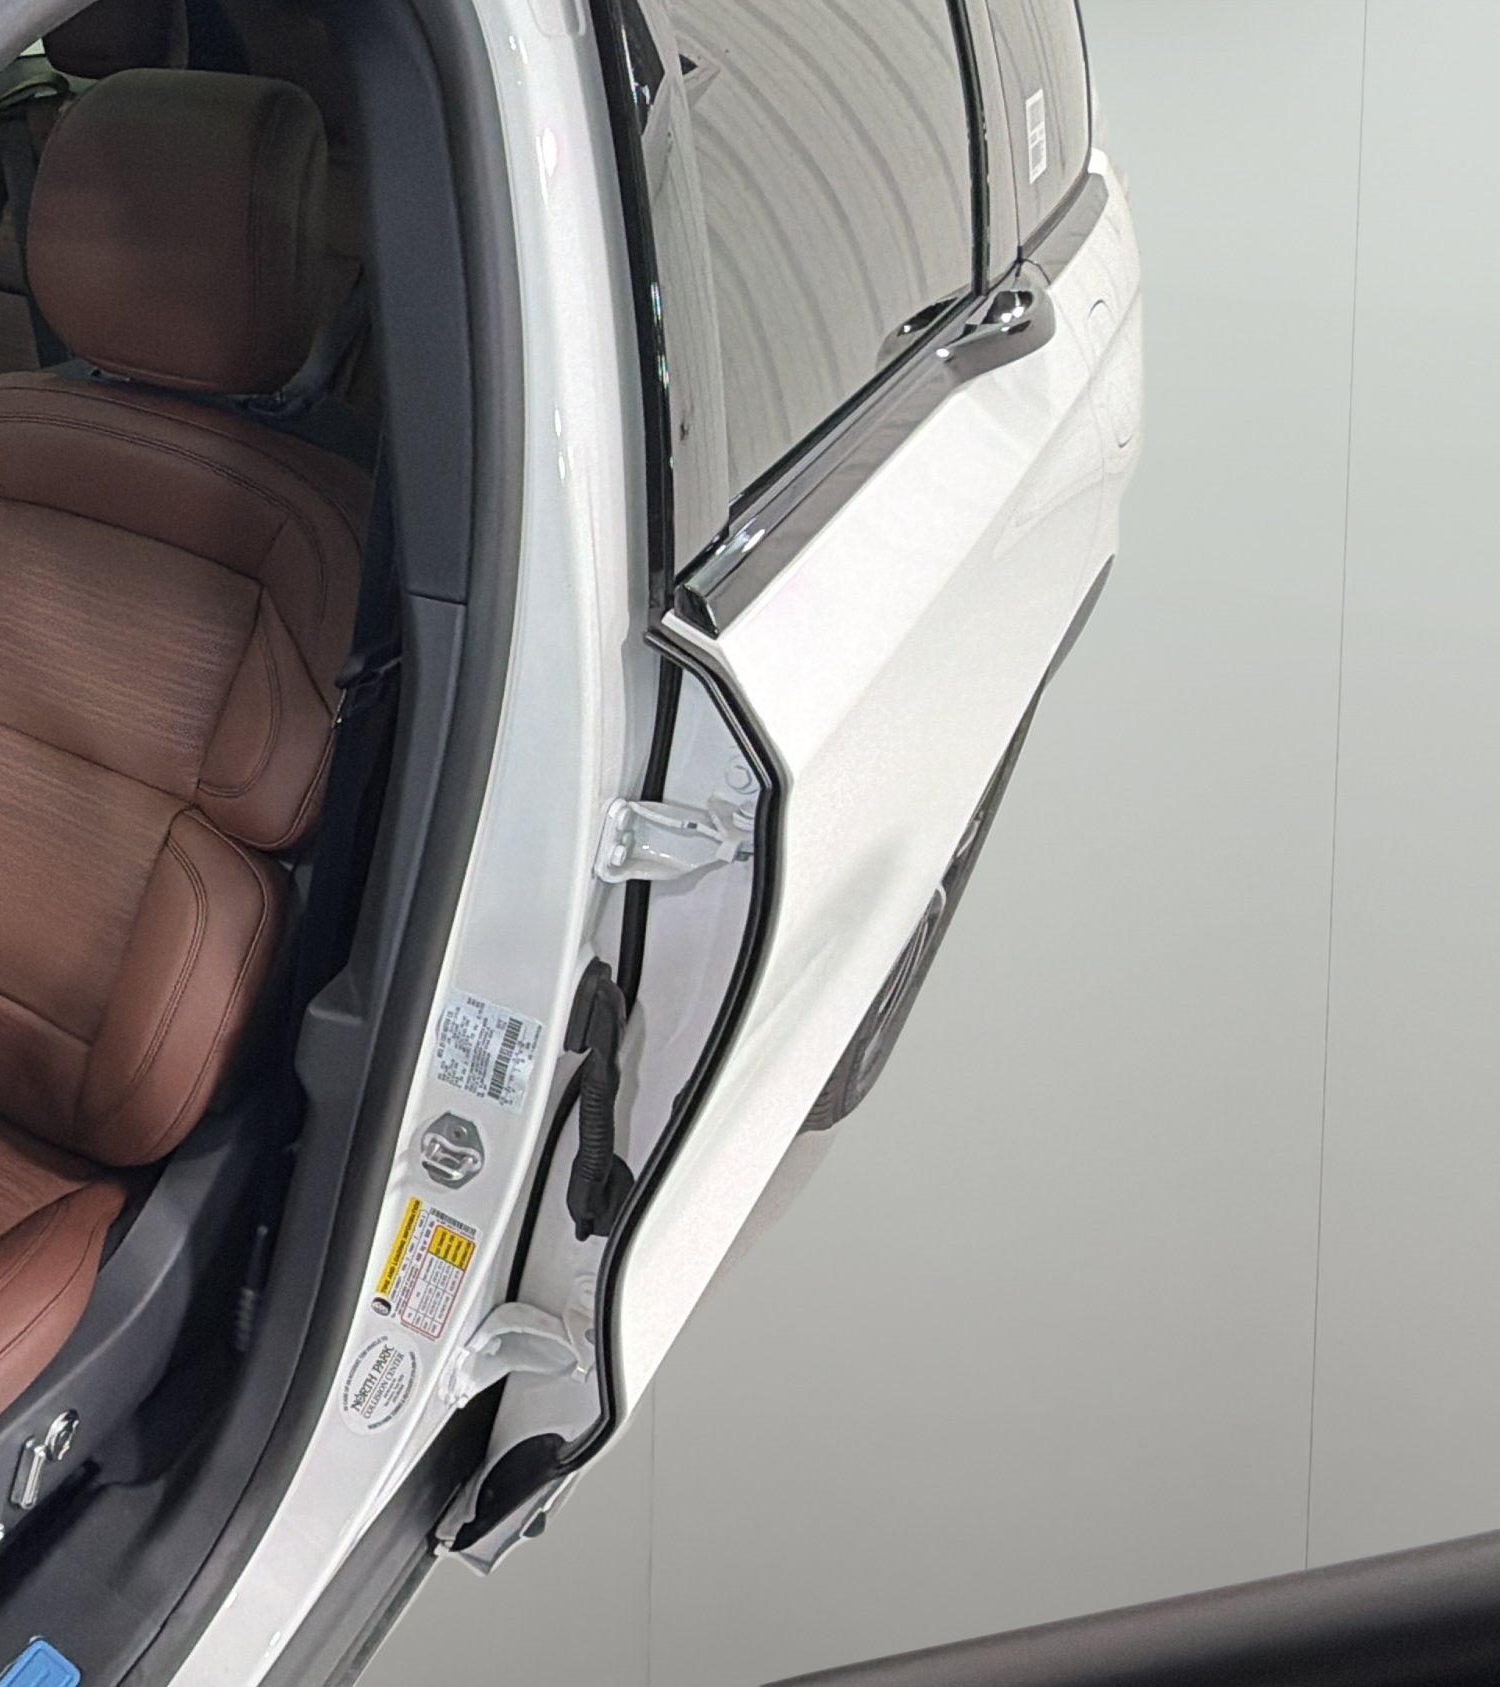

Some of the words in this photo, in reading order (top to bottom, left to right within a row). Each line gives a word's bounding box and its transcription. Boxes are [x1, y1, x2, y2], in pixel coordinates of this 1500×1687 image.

[385, 1264, 396, 1279] AND
[349, 1372, 378, 1412] NORTH
[371, 1343, 394, 1374] PARK
[362, 1379, 388, 1419] COLLISION
[383, 1351, 405, 1380] CENTER
